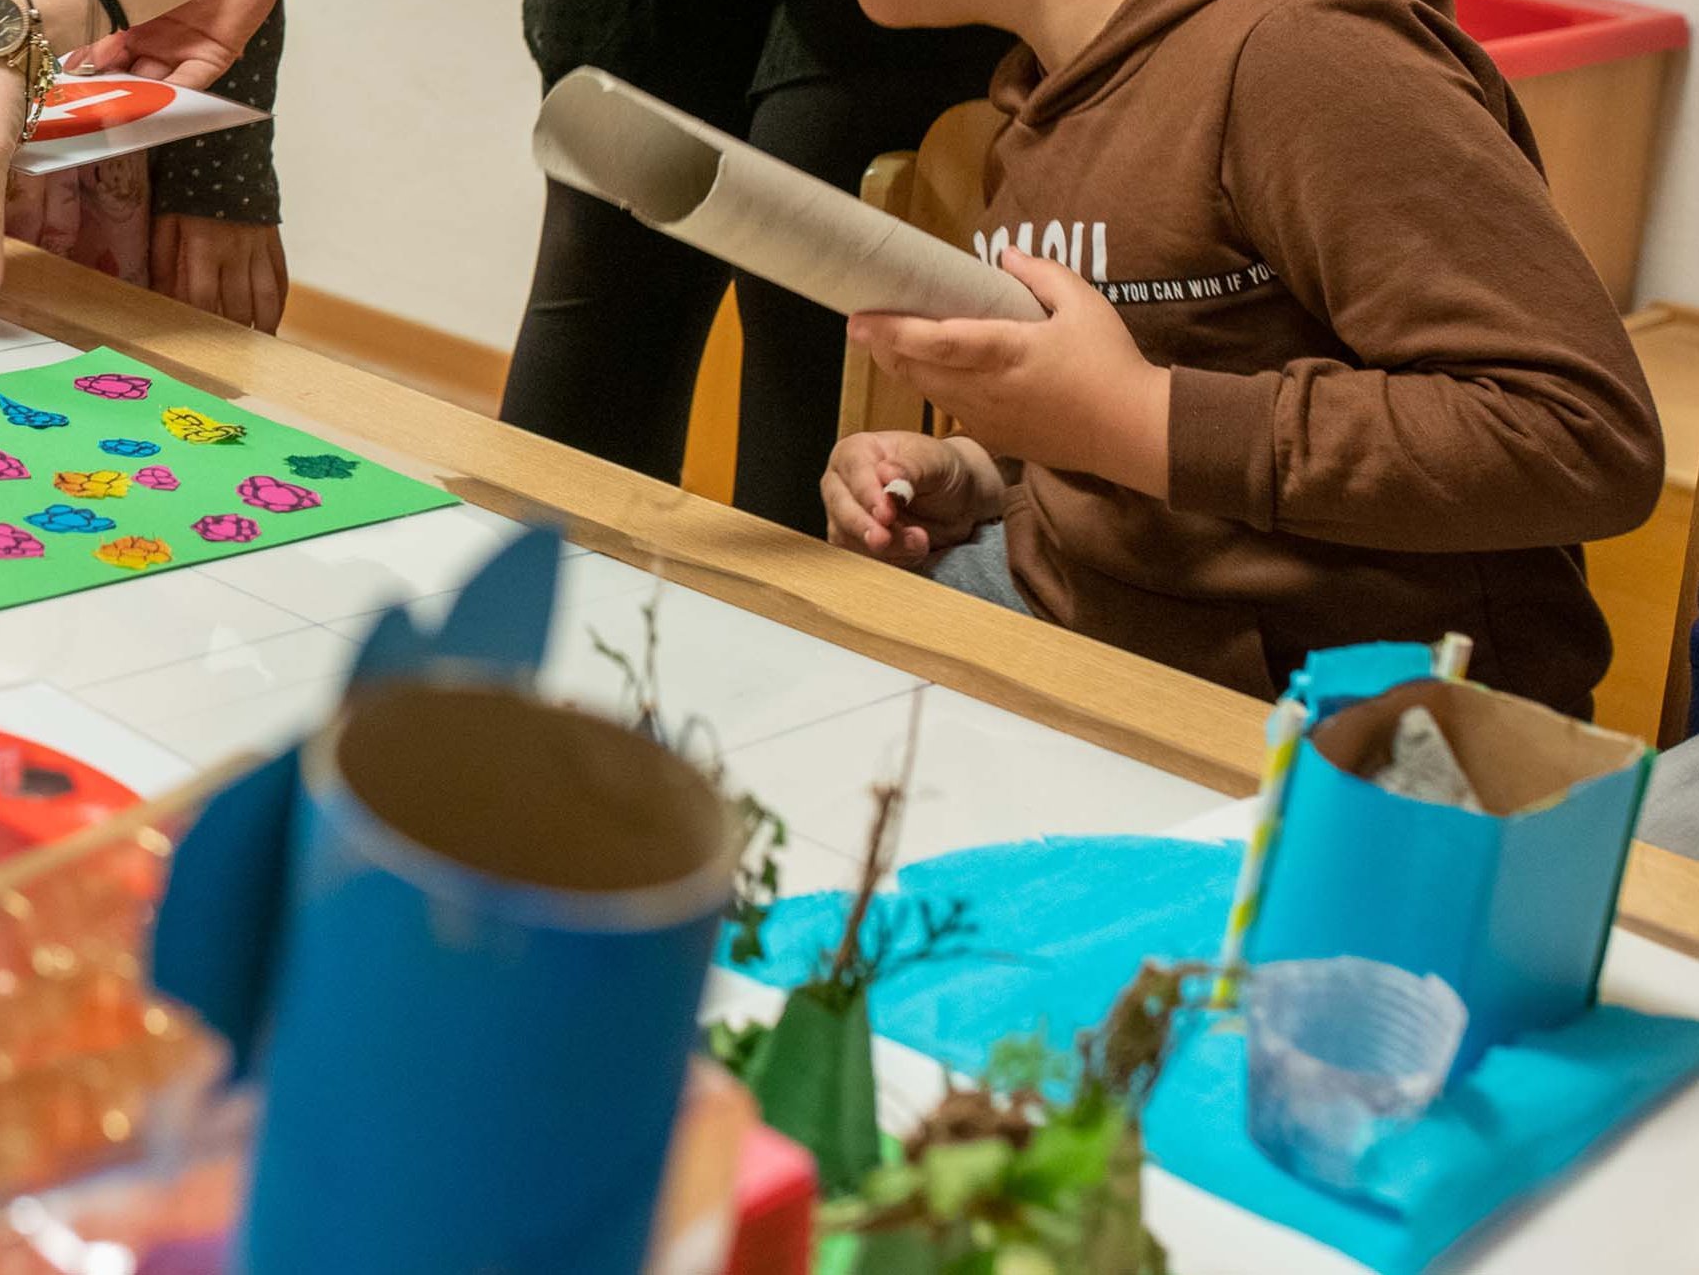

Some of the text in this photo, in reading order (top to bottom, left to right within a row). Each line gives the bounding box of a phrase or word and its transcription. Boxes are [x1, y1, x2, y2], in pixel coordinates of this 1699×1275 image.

[1152, 281, 1184, 300] CAN
[1187, 277, 1222, 299] WIN
[1225, 273, 1241, 292] IF
